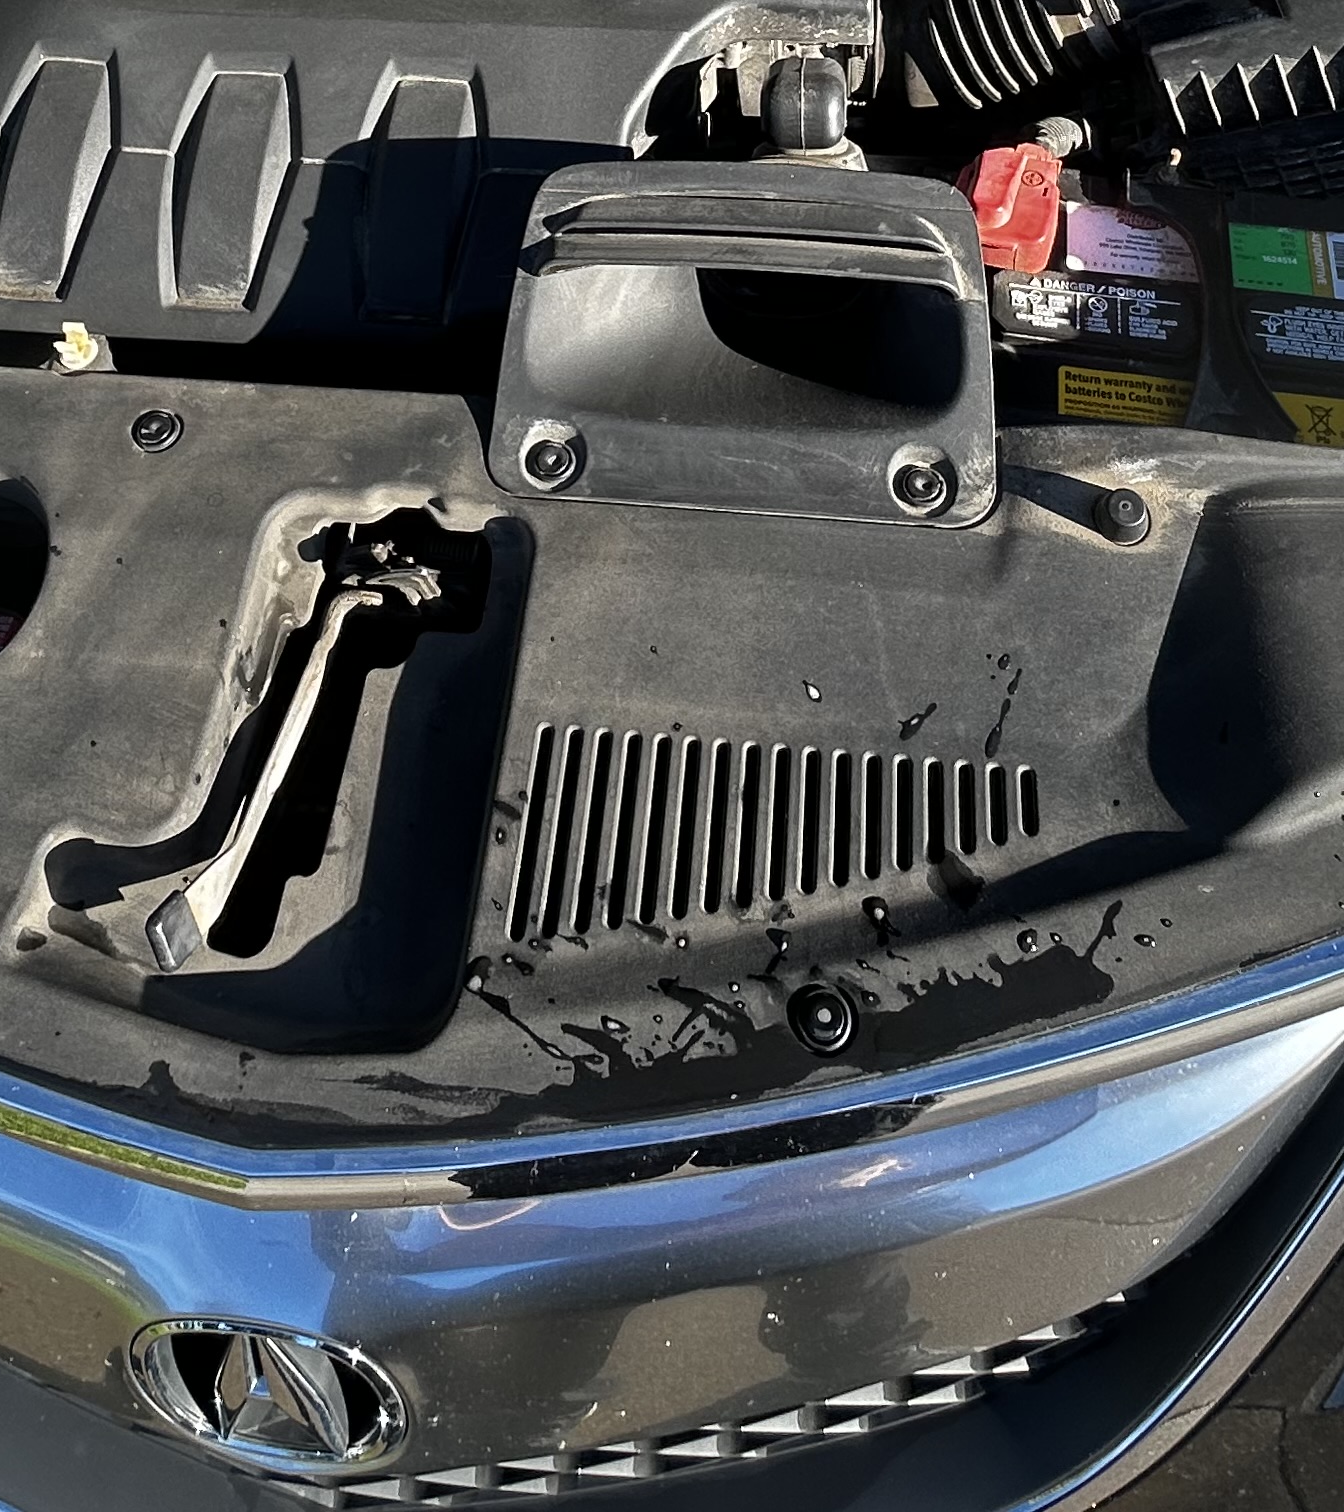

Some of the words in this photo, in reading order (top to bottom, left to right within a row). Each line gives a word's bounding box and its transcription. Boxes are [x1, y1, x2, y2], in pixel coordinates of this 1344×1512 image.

[1310, 230, 1328, 286] AUTOMOTIVE
[1044, 279, 1096, 292] DANGER
[1109, 287, 1156, 299] POISON
[1065, 371, 1101, 384] Return
[1103, 377, 1153, 392] warranty
[1155, 382, 1177, 394] and
[1065, 384, 1112, 399] batteries
[1114, 390, 1126, 401] to
[1128, 391, 1164, 407] Costco
